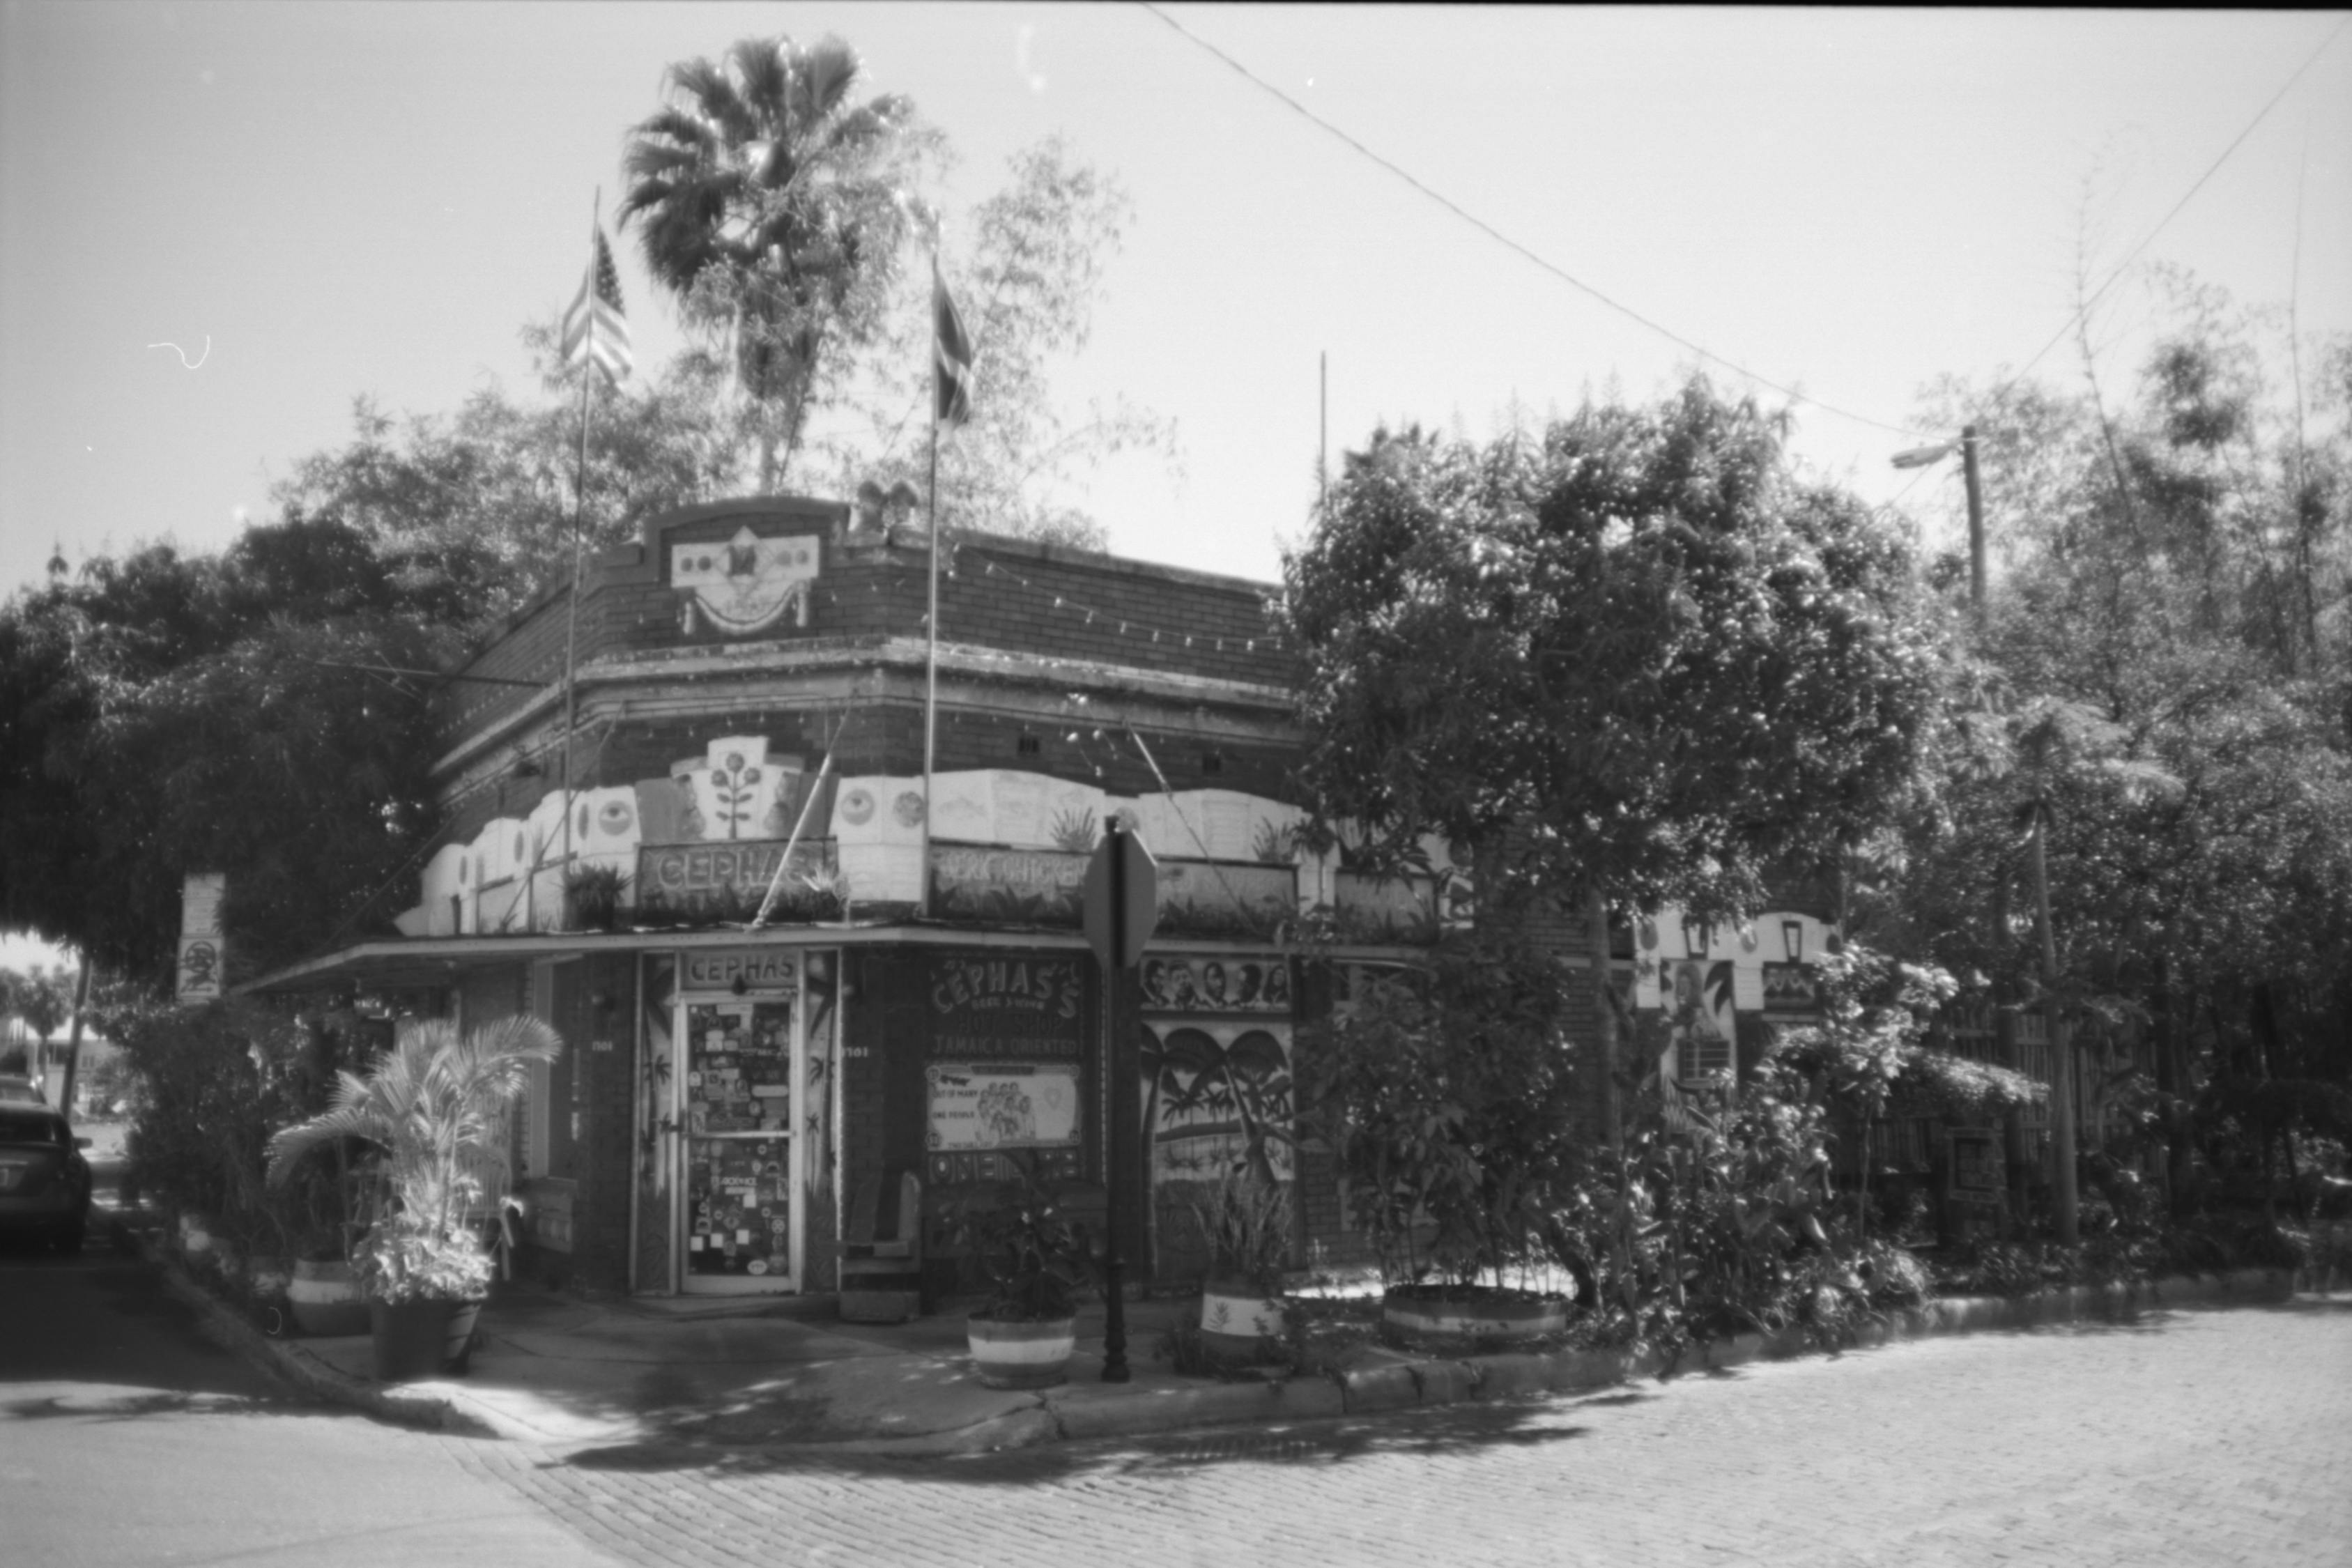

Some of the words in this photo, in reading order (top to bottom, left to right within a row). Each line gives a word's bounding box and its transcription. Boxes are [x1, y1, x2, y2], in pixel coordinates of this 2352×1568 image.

[690, 956, 795, 981] CEPHAS
[932, 1035, 1004, 1054] JAMAICA
[1010, 1037, 1077, 1054] ORIENTED
